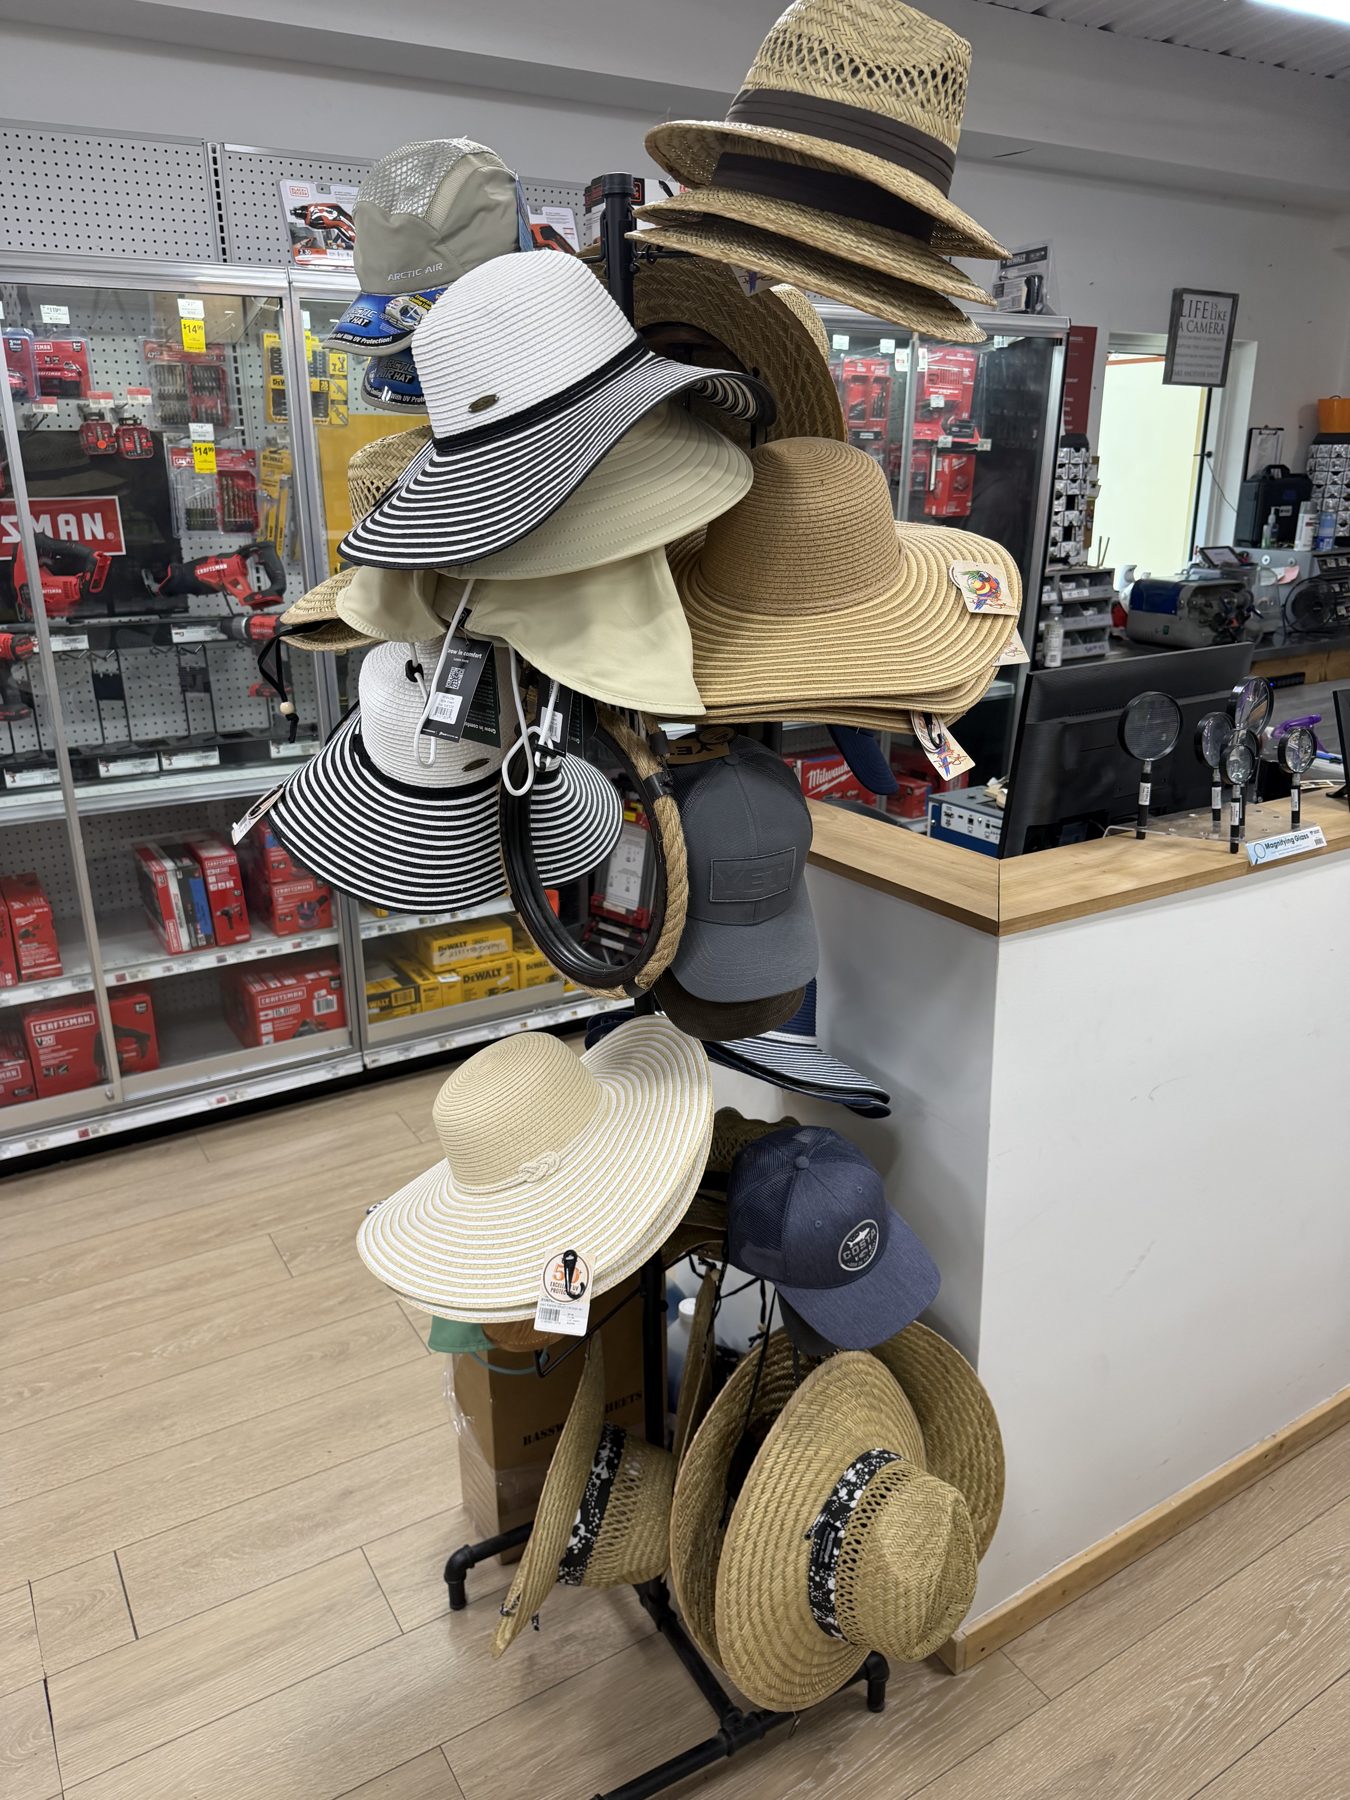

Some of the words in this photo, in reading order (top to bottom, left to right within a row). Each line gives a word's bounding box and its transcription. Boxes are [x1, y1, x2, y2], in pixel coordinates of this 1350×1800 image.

[387, 268, 422, 281] ARCTIC
[425, 262, 443, 274] AIR
[1180, 299, 1210, 320] LIFE
[1209, 309, 1227, 322] LIKE
[1186, 319, 1225, 335] CAMERA
[393, 371, 413, 383] HAT
[1264, 837, 1296, 850] Magnifying
[1294, 832, 1310, 843] Glass
[462, 967, 503, 984] DEWALT
[261, 990, 304, 1005] CRAFTSMAN
[35, 1014, 91, 1033] CRAFTSMAN
